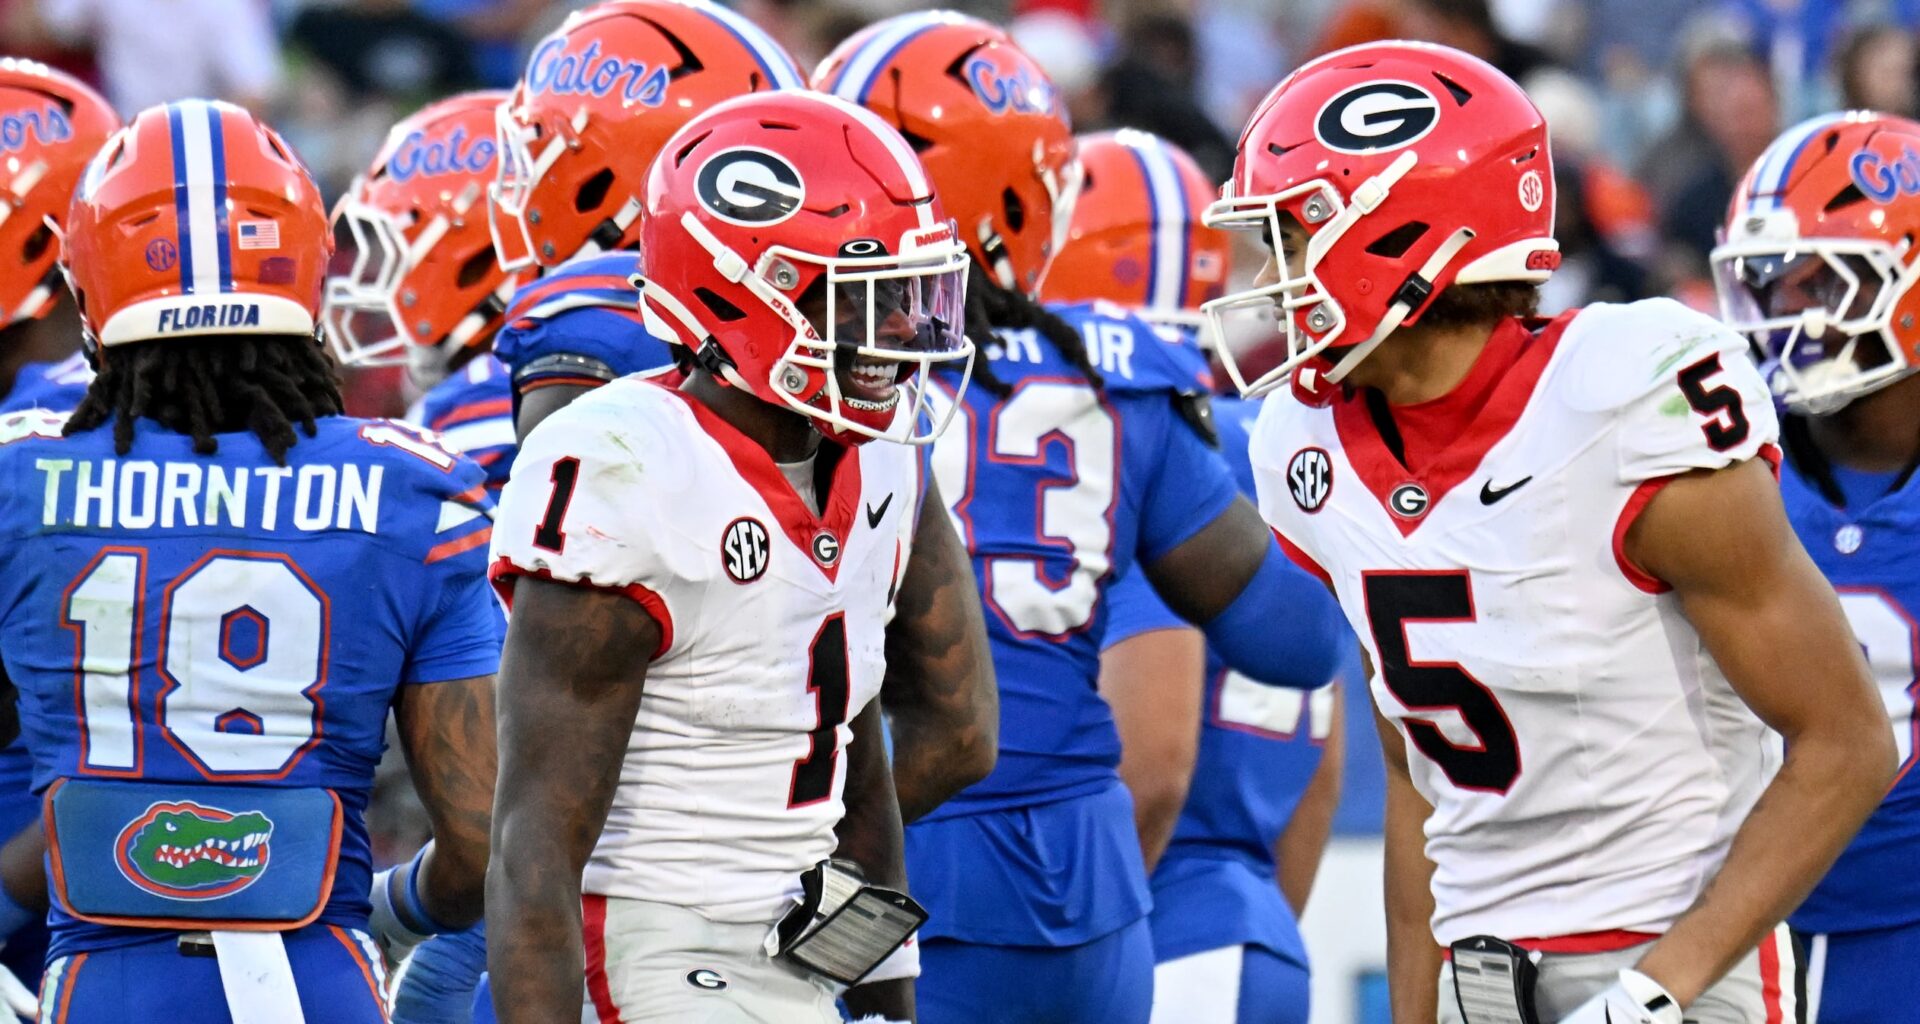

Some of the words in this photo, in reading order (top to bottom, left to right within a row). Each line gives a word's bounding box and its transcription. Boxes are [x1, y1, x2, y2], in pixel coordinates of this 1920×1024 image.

[529, 36, 669, 107] Gators
[0, 108, 71, 152] ors
[1316, 82, 1437, 152] G
[388, 126, 517, 182] Gato
[697, 149, 802, 222] G
[158, 304, 260, 333] FLORIDA
[1677, 351, 1749, 453] 5
[35, 458, 384, 534] THORNTON
[533, 456, 581, 555] 1
[1287, 449, 1332, 510] SEC
[1391, 485, 1428, 517] G
[724, 519, 768, 581] SEC
[812, 533, 839, 564] G
[59, 546, 331, 781] 18
[1361, 570, 1522, 797] 5
[787, 611, 851, 811] 1
[686, 969, 728, 990] G
